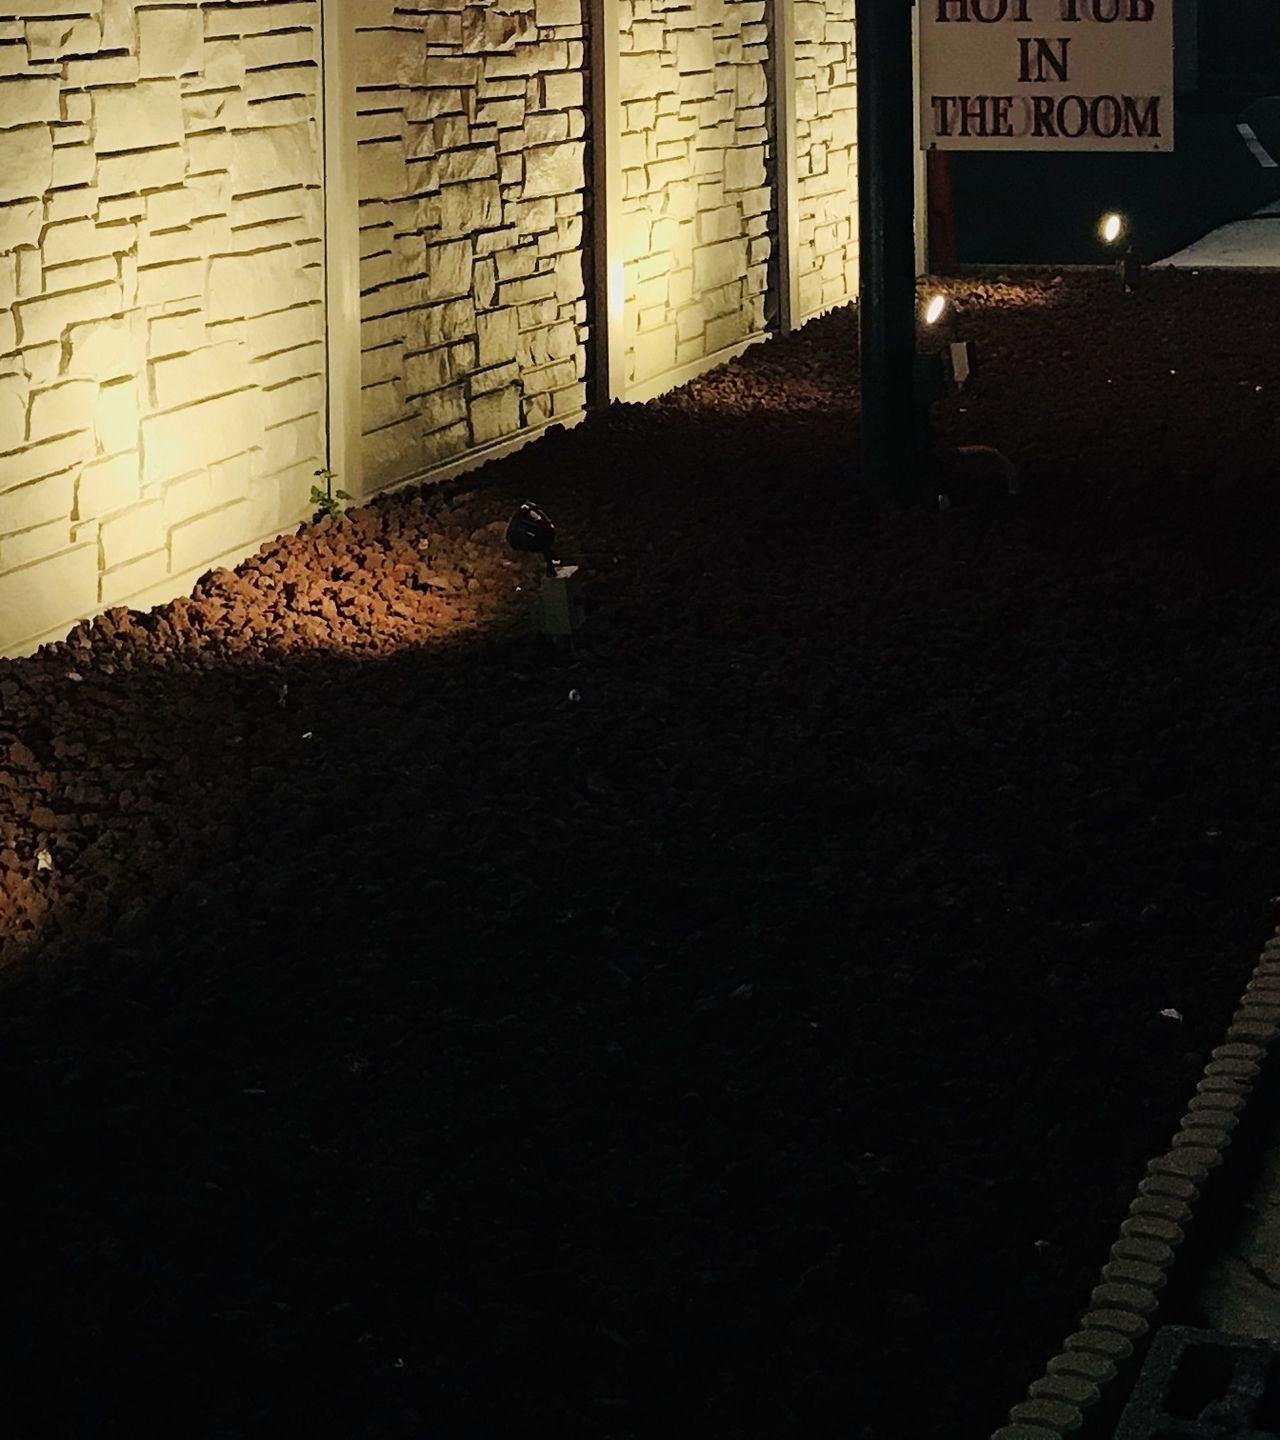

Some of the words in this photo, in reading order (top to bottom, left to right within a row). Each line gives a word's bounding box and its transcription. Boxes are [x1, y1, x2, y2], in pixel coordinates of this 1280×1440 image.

[1017, 37, 1071, 82] IN
[931, 95, 1013, 137] THE
[1031, 94, 1161, 138] ROOM
